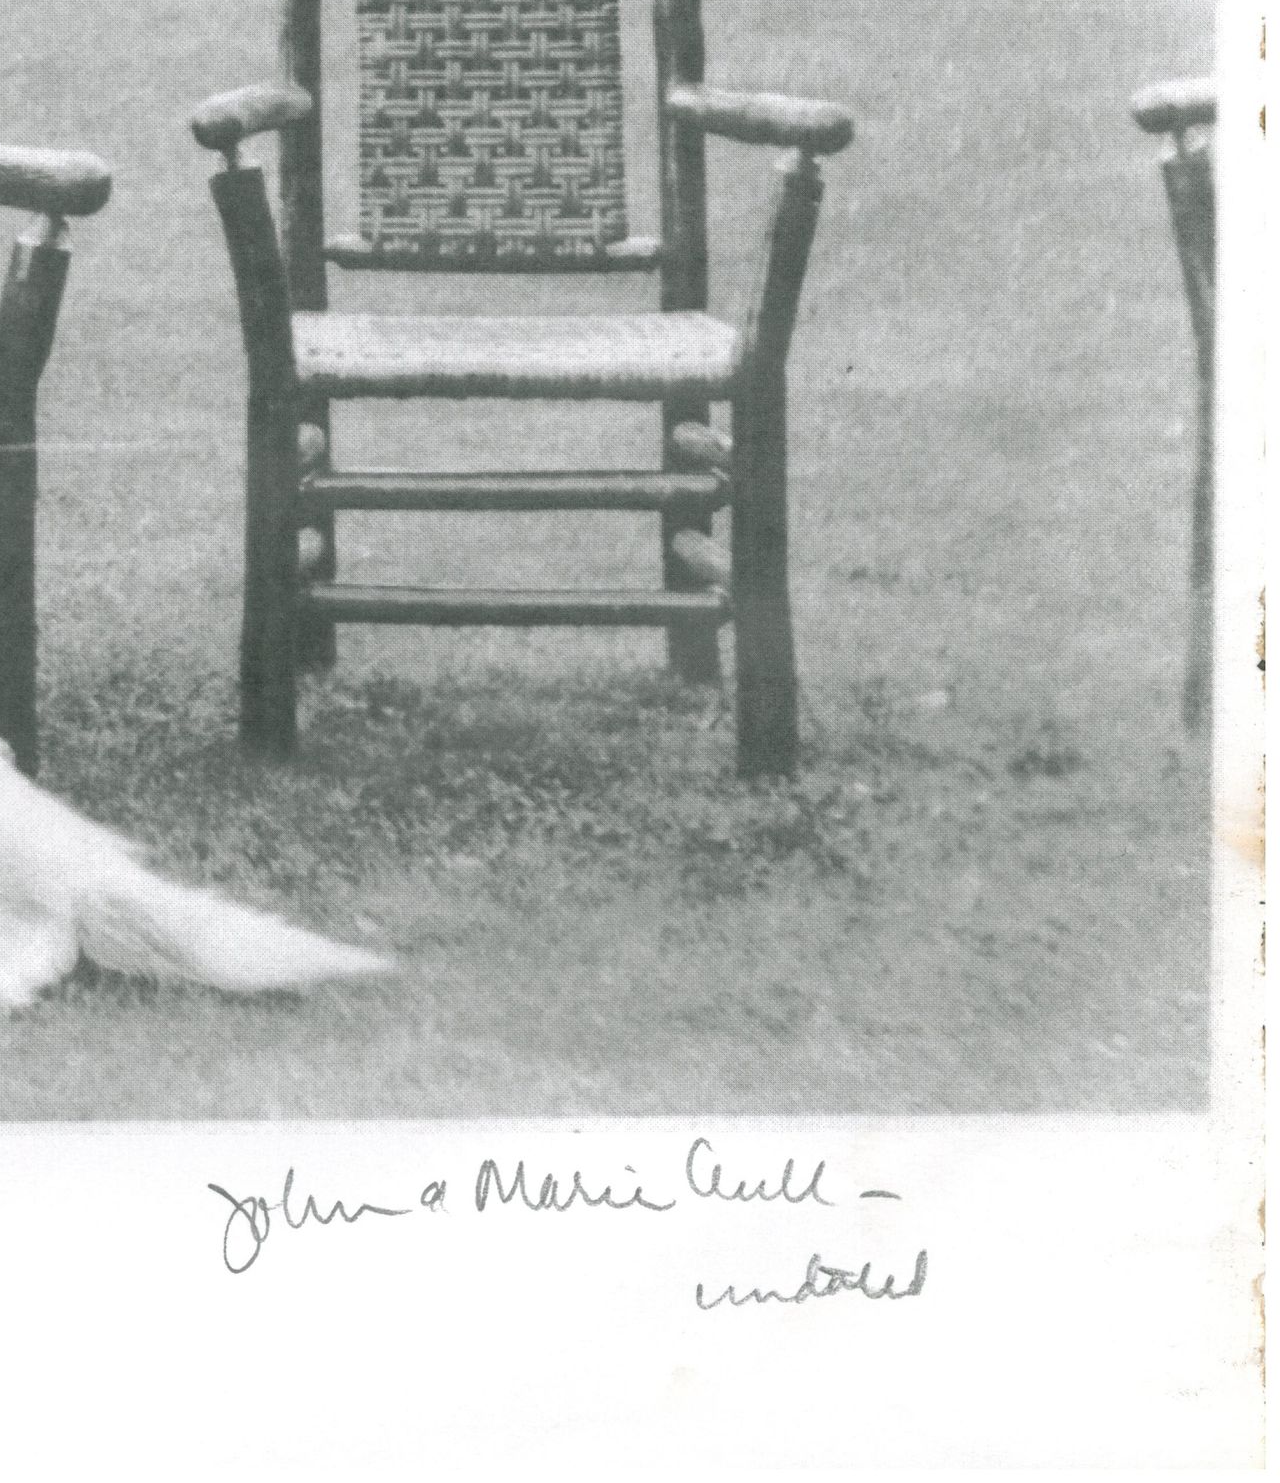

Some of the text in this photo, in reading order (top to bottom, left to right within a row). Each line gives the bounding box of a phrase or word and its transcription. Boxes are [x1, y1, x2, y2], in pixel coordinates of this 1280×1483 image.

[207, 1167, 411, 1275] John
[475, 1159, 677, 1213] Marie
[695, 1248, 928, 1311] undated
